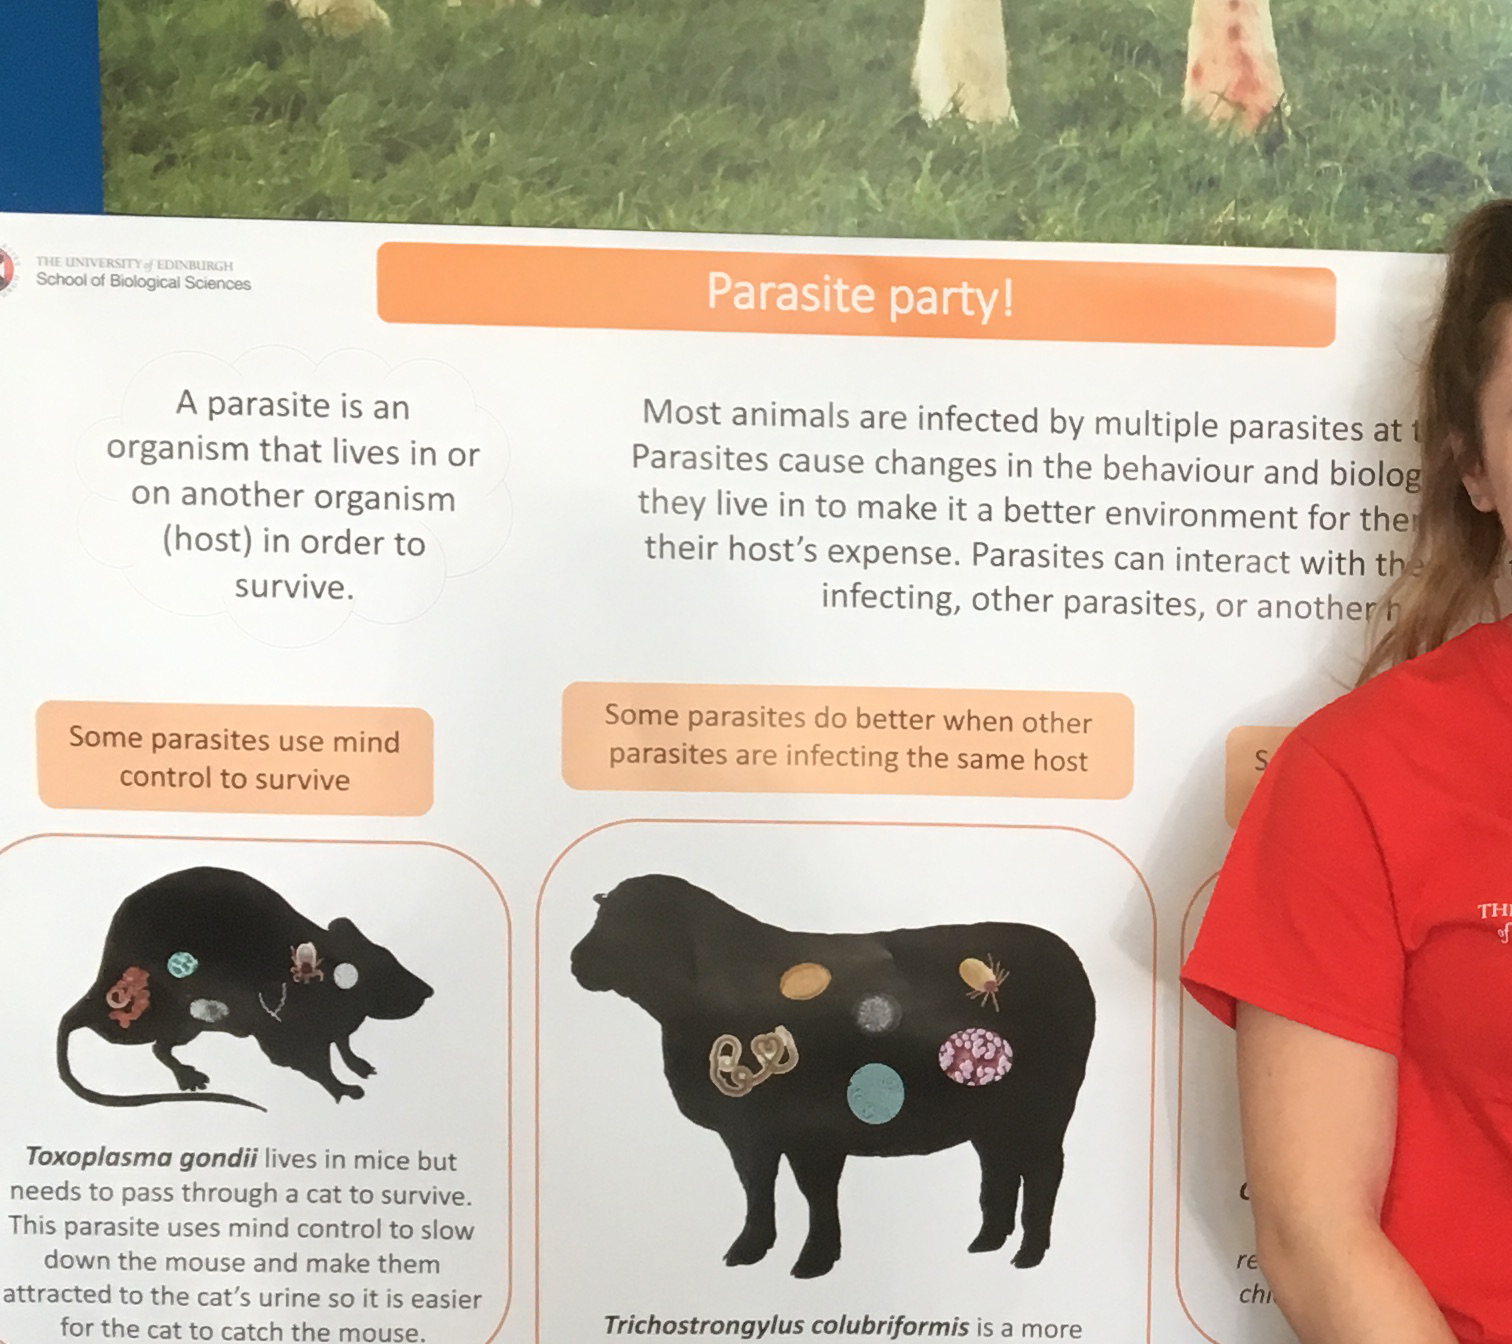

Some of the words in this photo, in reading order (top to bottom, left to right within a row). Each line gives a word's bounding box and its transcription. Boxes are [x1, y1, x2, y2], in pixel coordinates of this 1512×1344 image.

[36, 256, 61, 267] THE
[65, 257, 142, 269] UNIVERSITY
[156, 259, 233, 271] EDINBURGH
[36, 271, 87, 286] School
[90, 273, 106, 287] of
[110, 273, 181, 292] Biological
[184, 275, 252, 291] Sciences
[709, 272, 875, 313] Parasite
[890, 279, 1012, 324] party!
[176, 389, 198, 414] A
[208, 392, 330, 420] parasite
[341, 392, 363, 419] is
[373, 400, 409, 419] an
[644, 398, 721, 425] Most
[731, 401, 849, 428] animals
[859, 410, 907, 430] are
[918, 404, 1038, 433] infected
[1050, 407, 1085, 440] by
[1095, 410, 1218, 442] multiple
[1229, 415, 1363, 443] parasites
[1373, 419, 1403, 442] at
[107, 435, 248, 465] organism
[259, 435, 322, 463] that
[333, 437, 399, 465] lives
[411, 440, 436, 466] in
[448, 447, 480, 467] or
[632, 443, 768, 471] Parasites
[778, 453, 864, 474] cause
[875, 449, 997, 482] changes
[1008, 452, 1032, 478] in
[1042, 452, 1092, 480] the
[1104, 454, 1254, 483] behaviour
[1264, 459, 1318, 485] and
[1330, 459, 1422, 494] biolog
[132, 485, 169, 505] on
[181, 481, 305, 508] another
[314, 486, 455, 516] organism
[638, 488, 706, 521] they
[717, 489, 768, 516] live
[779, 491, 804, 517] in
[814, 495, 846, 518] to
[858, 494, 937, 520] make
[948, 495, 967, 521] it
[977, 502, 992, 522] a
[1004, 496, 1096, 524] better
[1105, 502, 1298, 529] environment
[1307, 503, 1351, 531] for
[164, 524, 251, 557] (host)
[263, 527, 289, 553] in
[300, 528, 385, 555] order
[394, 533, 425, 556] to
[644, 533, 719, 560] their
[828, 544, 960, 569] expense.
[972, 541, 1104, 569] Parasites
[1114, 551, 1164, 570] can
[1176, 547, 1290, 574] interact
[1300, 549, 1365, 576] with
[235, 574, 353, 600] survive.
[822, 581, 960, 616] infecting,
[972, 585, 1054, 612] other
[1064, 590, 1204, 620] parasites,
[1216, 598, 1248, 617] or
[1257, 594, 1378, 621] another
[605, 703, 679, 726] Some
[688, 706, 805, 731] parasites
[814, 705, 847, 728] do
[856, 706, 936, 730] better
[942, 709, 1013, 732] when
[1022, 711, 1093, 734] other
[69, 724, 143, 748] Some
[152, 729, 270, 753] parasites
[279, 735, 324, 752] use
[334, 730, 399, 753] mind
[610, 743, 727, 767] parasites
[736, 748, 777, 766] are
[786, 743, 899, 772] infecting
[906, 745, 949, 769] the
[957, 752, 1025, 770] same
[1034, 748, 1088, 772] host
[120, 766, 211, 788] control
[219, 769, 247, 789] to
[255, 769, 350, 791] survive
[26, 1145, 173, 1170] Toxoplasma
[179, 1147, 259, 1172] gondii
[265, 1147, 317, 1169] lives
[325, 1149, 345, 1169] in
[354, 1149, 410, 1170] mice
[418, 1150, 457, 1171] but
[10, 1180, 82, 1201] needs
[88, 1183, 114, 1202] to
[121, 1186, 174, 1206] pass
[181, 1181, 277, 1208] through
[285, 1187, 298, 1203] a
[306, 1185, 342, 1204] cat
[348, 1185, 374, 1204] to
[381, 1186, 472, 1206] survive.
[7, 1214, 57, 1235] This
[64, 1217, 160, 1239] parasite
[167, 1221, 220, 1237] uses
[229, 1217, 289, 1238] mind
[297, 1218, 381, 1239] control
[388, 1220, 414, 1239] to
[421, 1219, 475, 1240] slow
[44, 1249, 110, 1269] down
[117, 1250, 157, 1271] the
[165, 1256, 246, 1272] mouse
[253, 1252, 298, 1273] and
[306, 1252, 370, 1273] make
[377, 1253, 440, 1274] them
[60, 1316, 94, 1337] for
[100, 1317, 140, 1339] the
[147, 1322, 182, 1340] cat
[188, 1322, 213, 1341] to
[220, 1321, 283, 1341] catch
[290, 1321, 330, 1342] the
[339, 1327, 425, 1343] mouse.
[604, 1314, 805, 1339] Trichostrongylus
[811, 1315, 970, 1339] colubriformis
[977, 1317, 993, 1337] is
[1000, 1322, 1013, 1337] a
[1022, 1323, 1082, 1339] more
